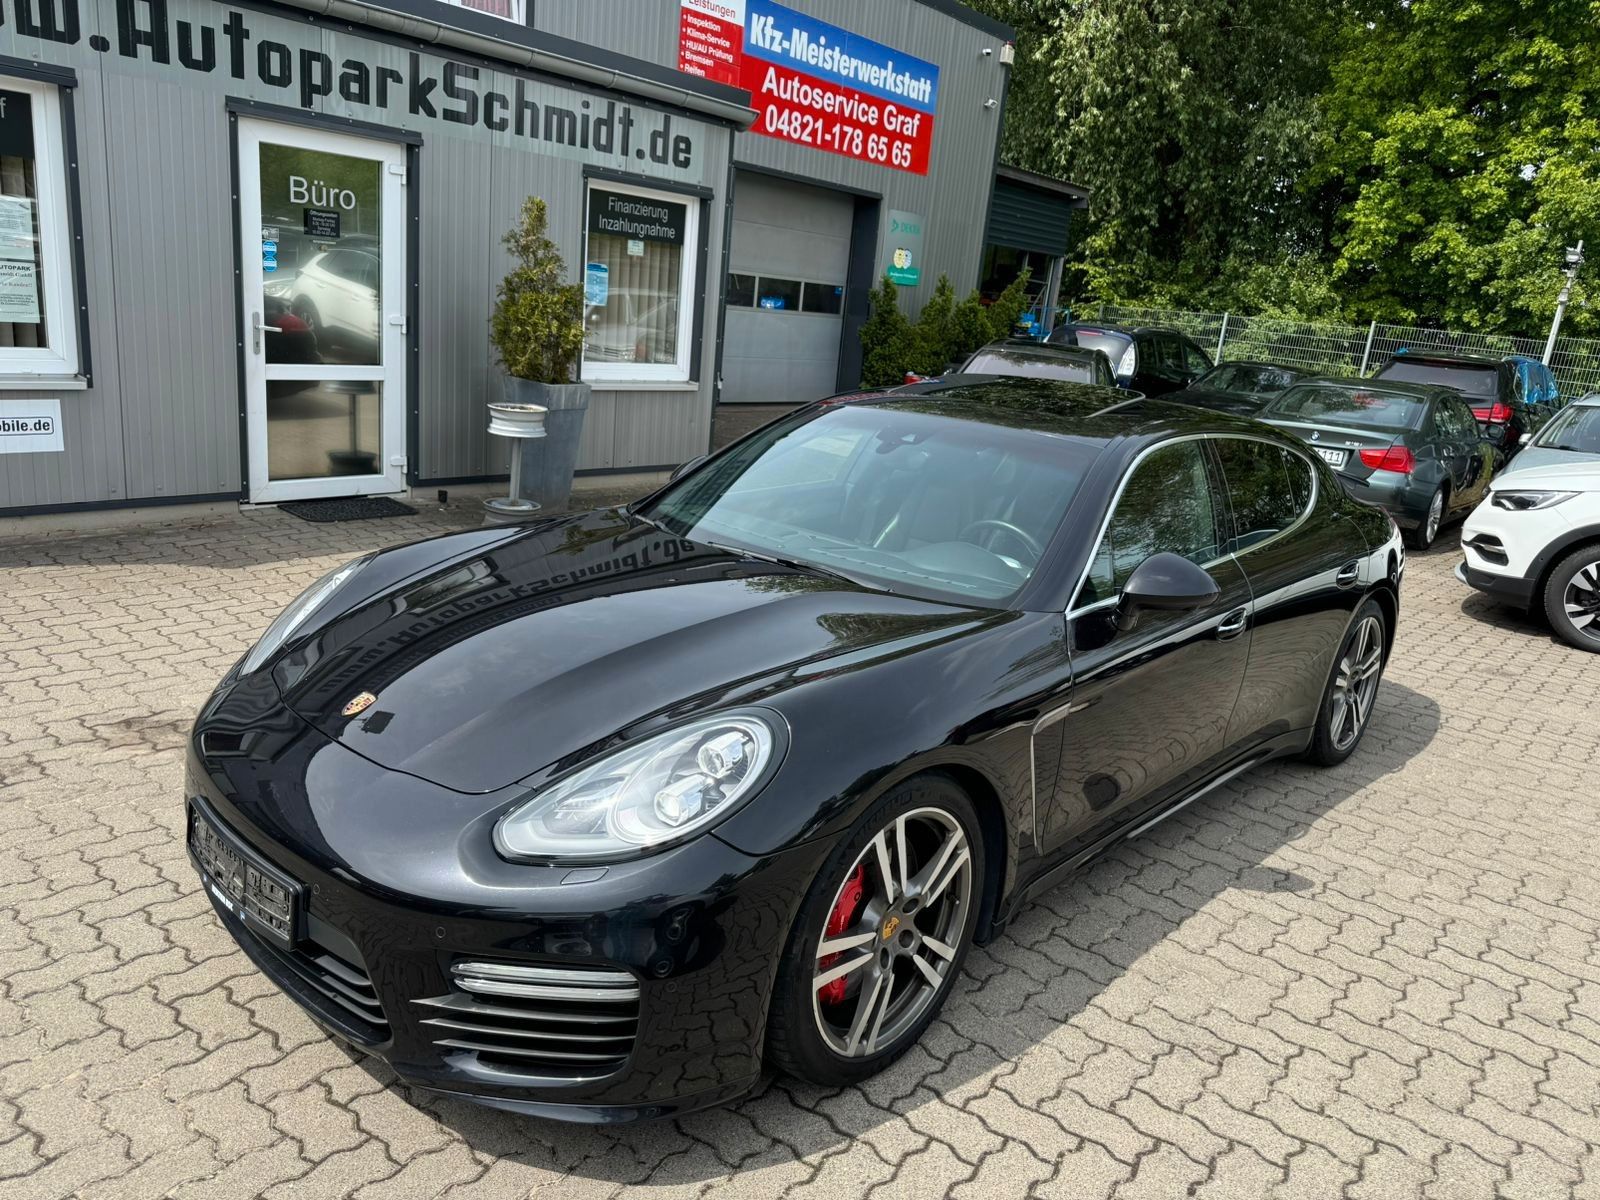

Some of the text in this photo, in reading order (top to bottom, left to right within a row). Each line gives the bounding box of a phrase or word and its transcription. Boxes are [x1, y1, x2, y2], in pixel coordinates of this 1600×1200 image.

[687, 14, 721, 32] Inspektion
[687, 27, 731, 48] Klima-Service
[685, 51, 714, 67] Bremsen
[686, 40, 733, 63] HU/AU Prüfung
[750, 12, 932, 104] Kfz-Meisterwerkstatt
[684, 63, 706, 77] Reifen
[0, 0, 691, 169] w.AutoparkSchmidt.de
[761, 66, 921, 138] Autoservice Graf
[765, 104, 912, 168] 04821-178 65 65
[289, 175, 356, 210] Büro
[608, 196, 669, 223] Finanzierung
[598, 214, 676, 239] Inzahlungnahme
